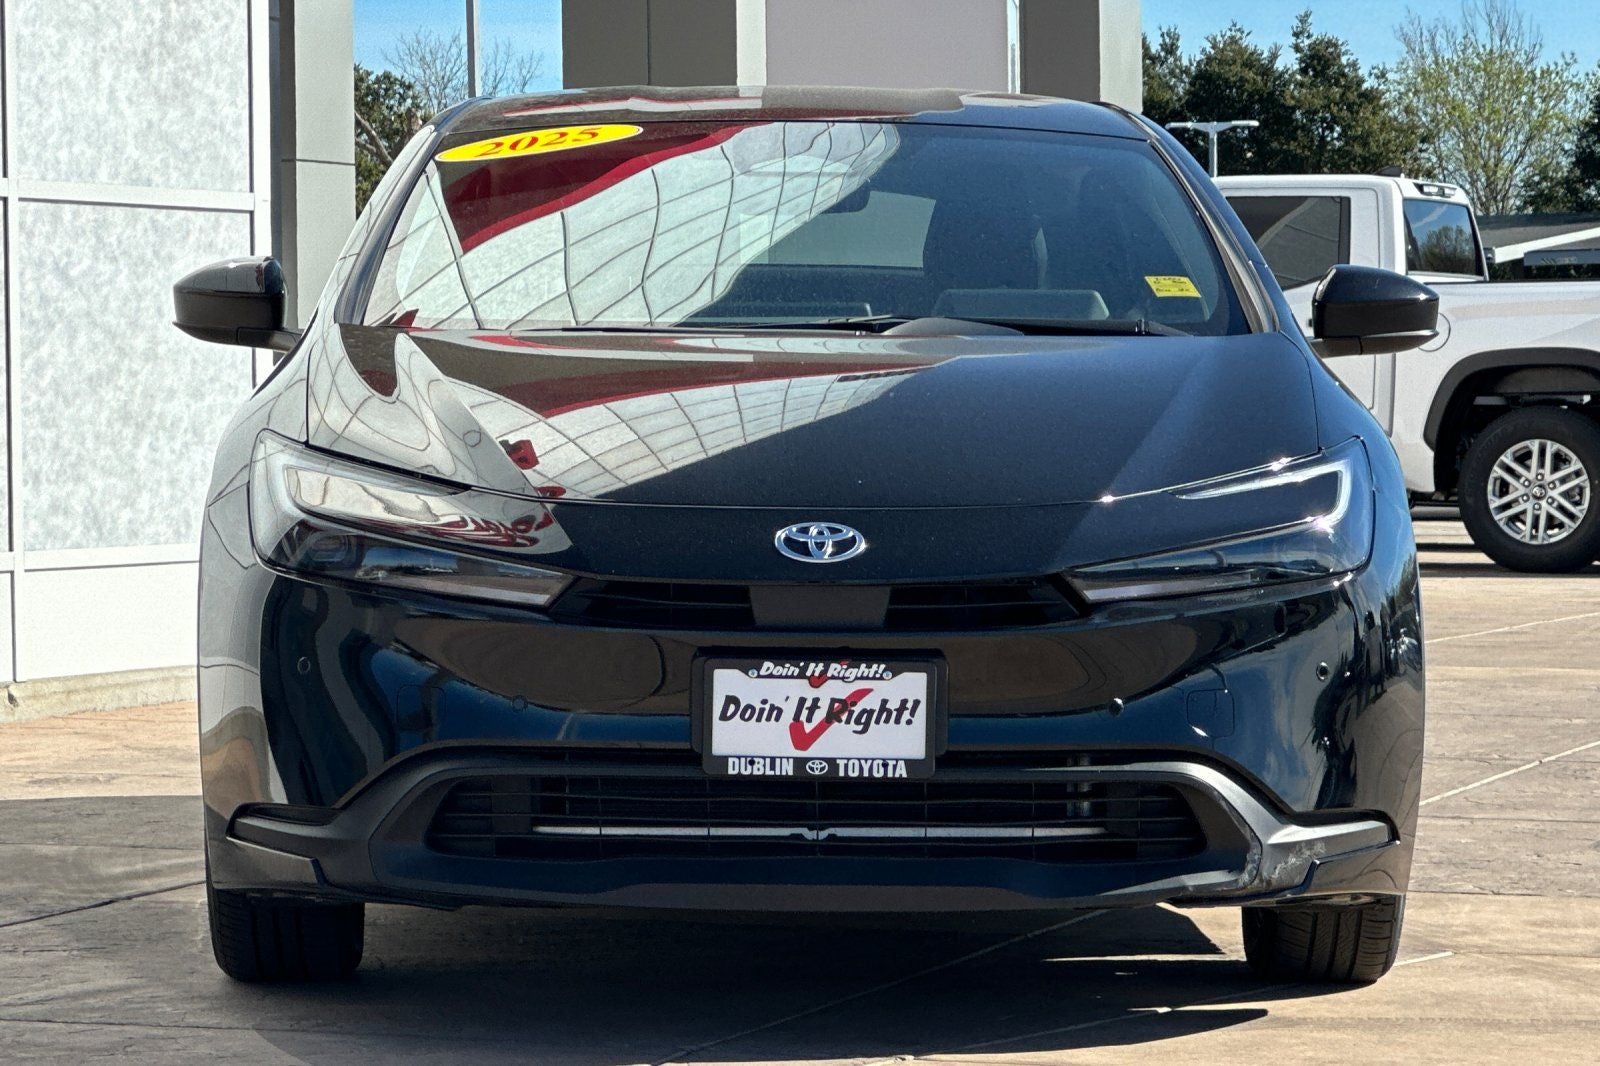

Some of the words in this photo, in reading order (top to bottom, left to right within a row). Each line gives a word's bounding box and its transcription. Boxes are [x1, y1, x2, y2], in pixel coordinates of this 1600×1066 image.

[474, 127, 602, 157] 2025
[760, 661, 804, 676] Doin'
[806, 663, 824, 677] It
[827, 663, 886, 682] Right!
[719, 695, 789, 723] Doin'
[793, 697, 821, 723] It
[825, 698, 921, 735] Right!
[727, 757, 794, 776] DUBLIN
[836, 759, 907, 778] TOYOTA
